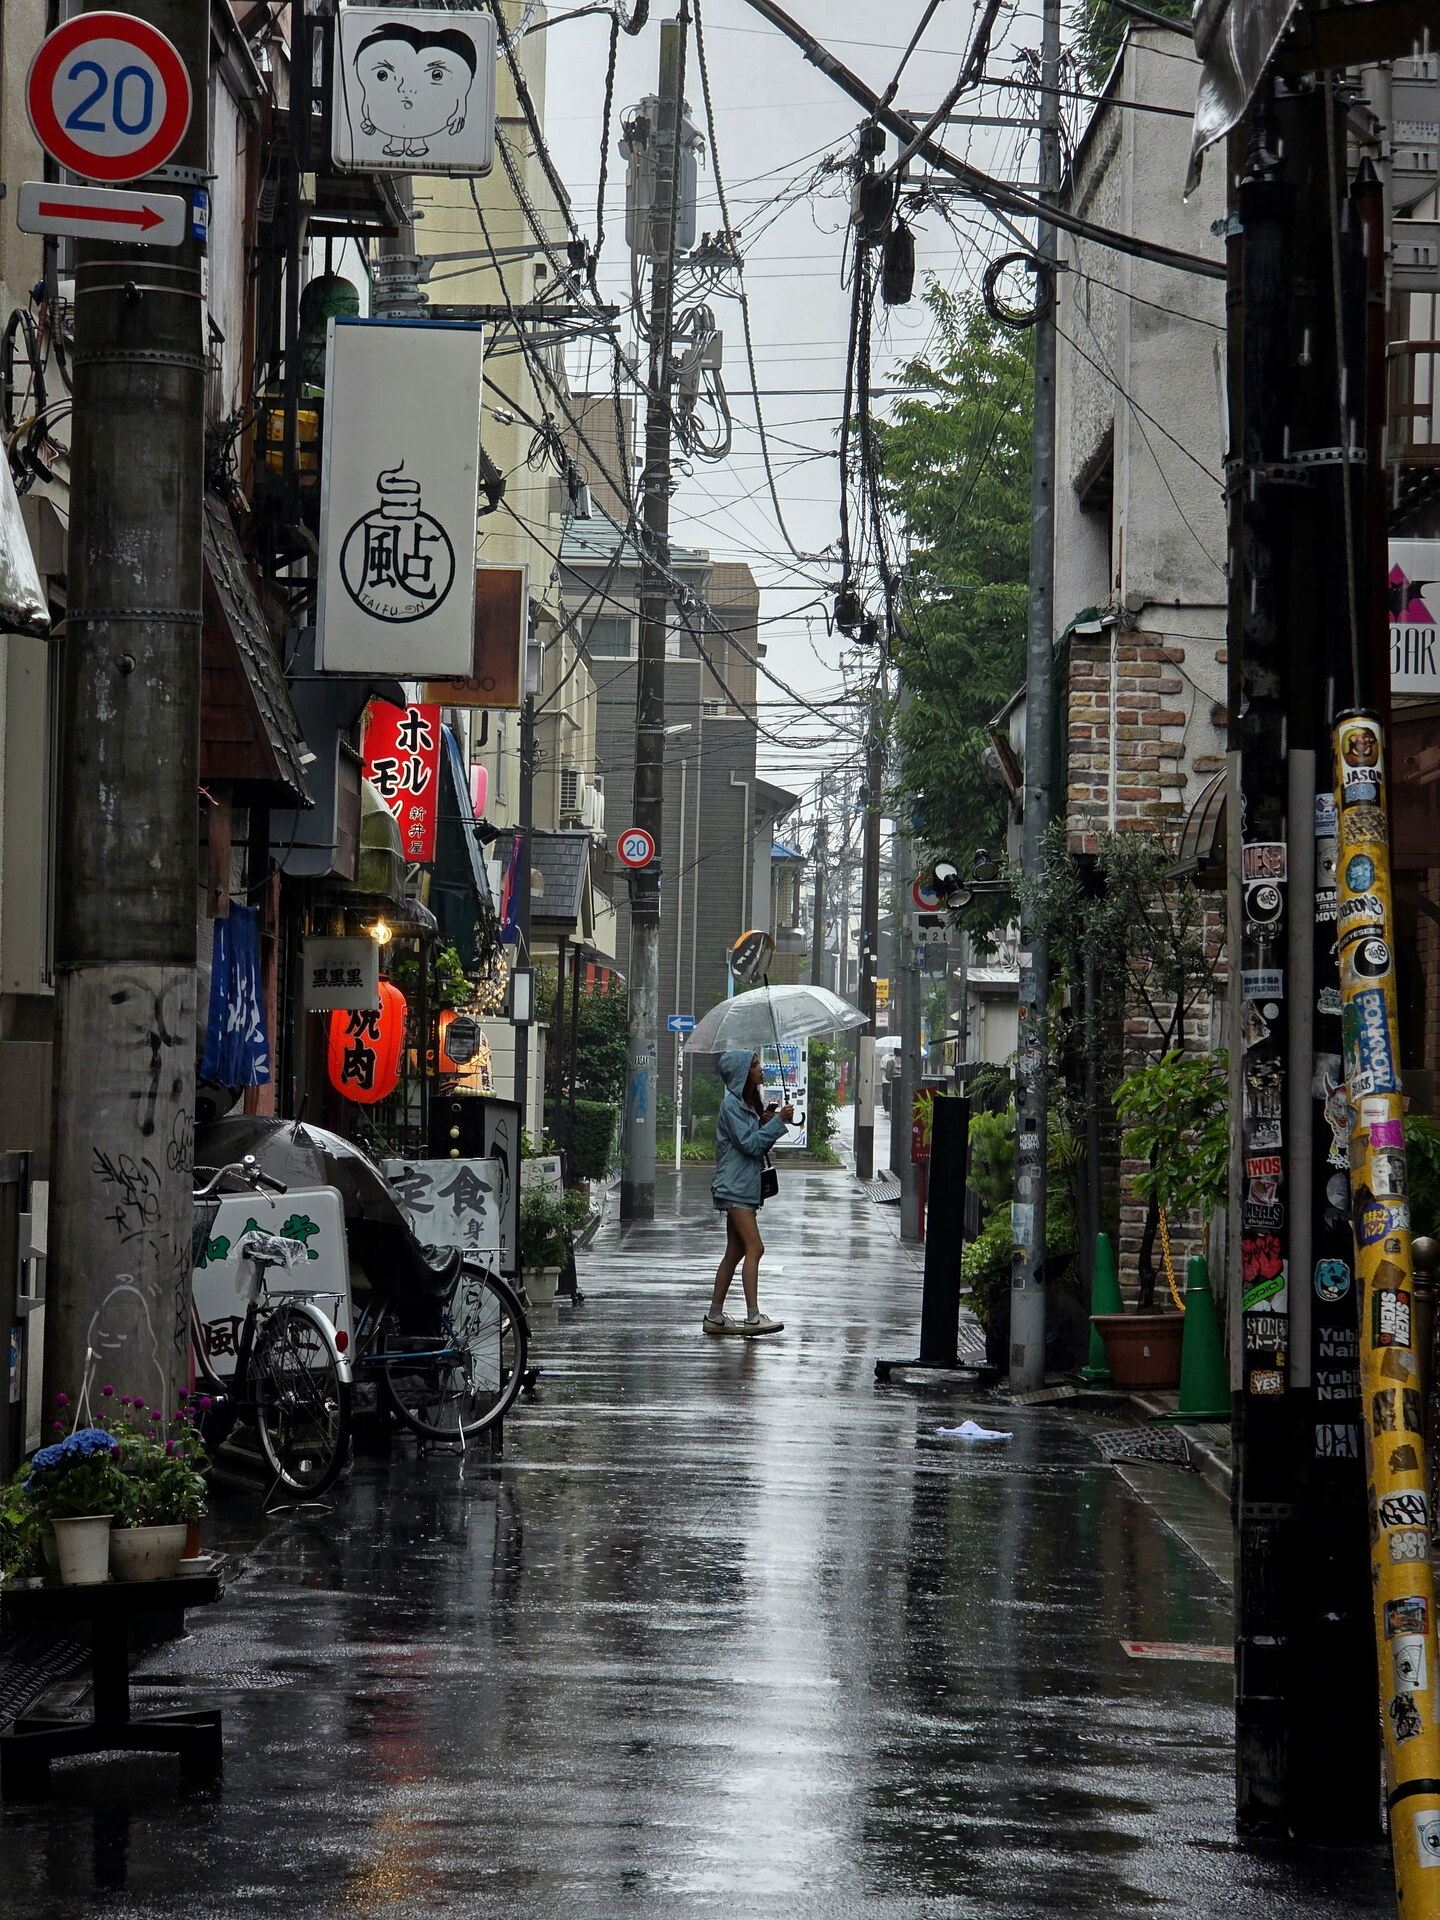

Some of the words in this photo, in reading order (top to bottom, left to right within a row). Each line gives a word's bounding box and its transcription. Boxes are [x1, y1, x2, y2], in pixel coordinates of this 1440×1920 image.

[65, 61, 154, 135] 20
[408, 806, 427, 855] 新井屋
[625, 839, 648, 858] 20
[312, 967, 364, 988] 黒黒黒
[1380, 1291, 1397, 1335] SKEM
[1394, 1301, 1410, 1346] SKEM
[1255, 1378, 1281, 1392] YES!
